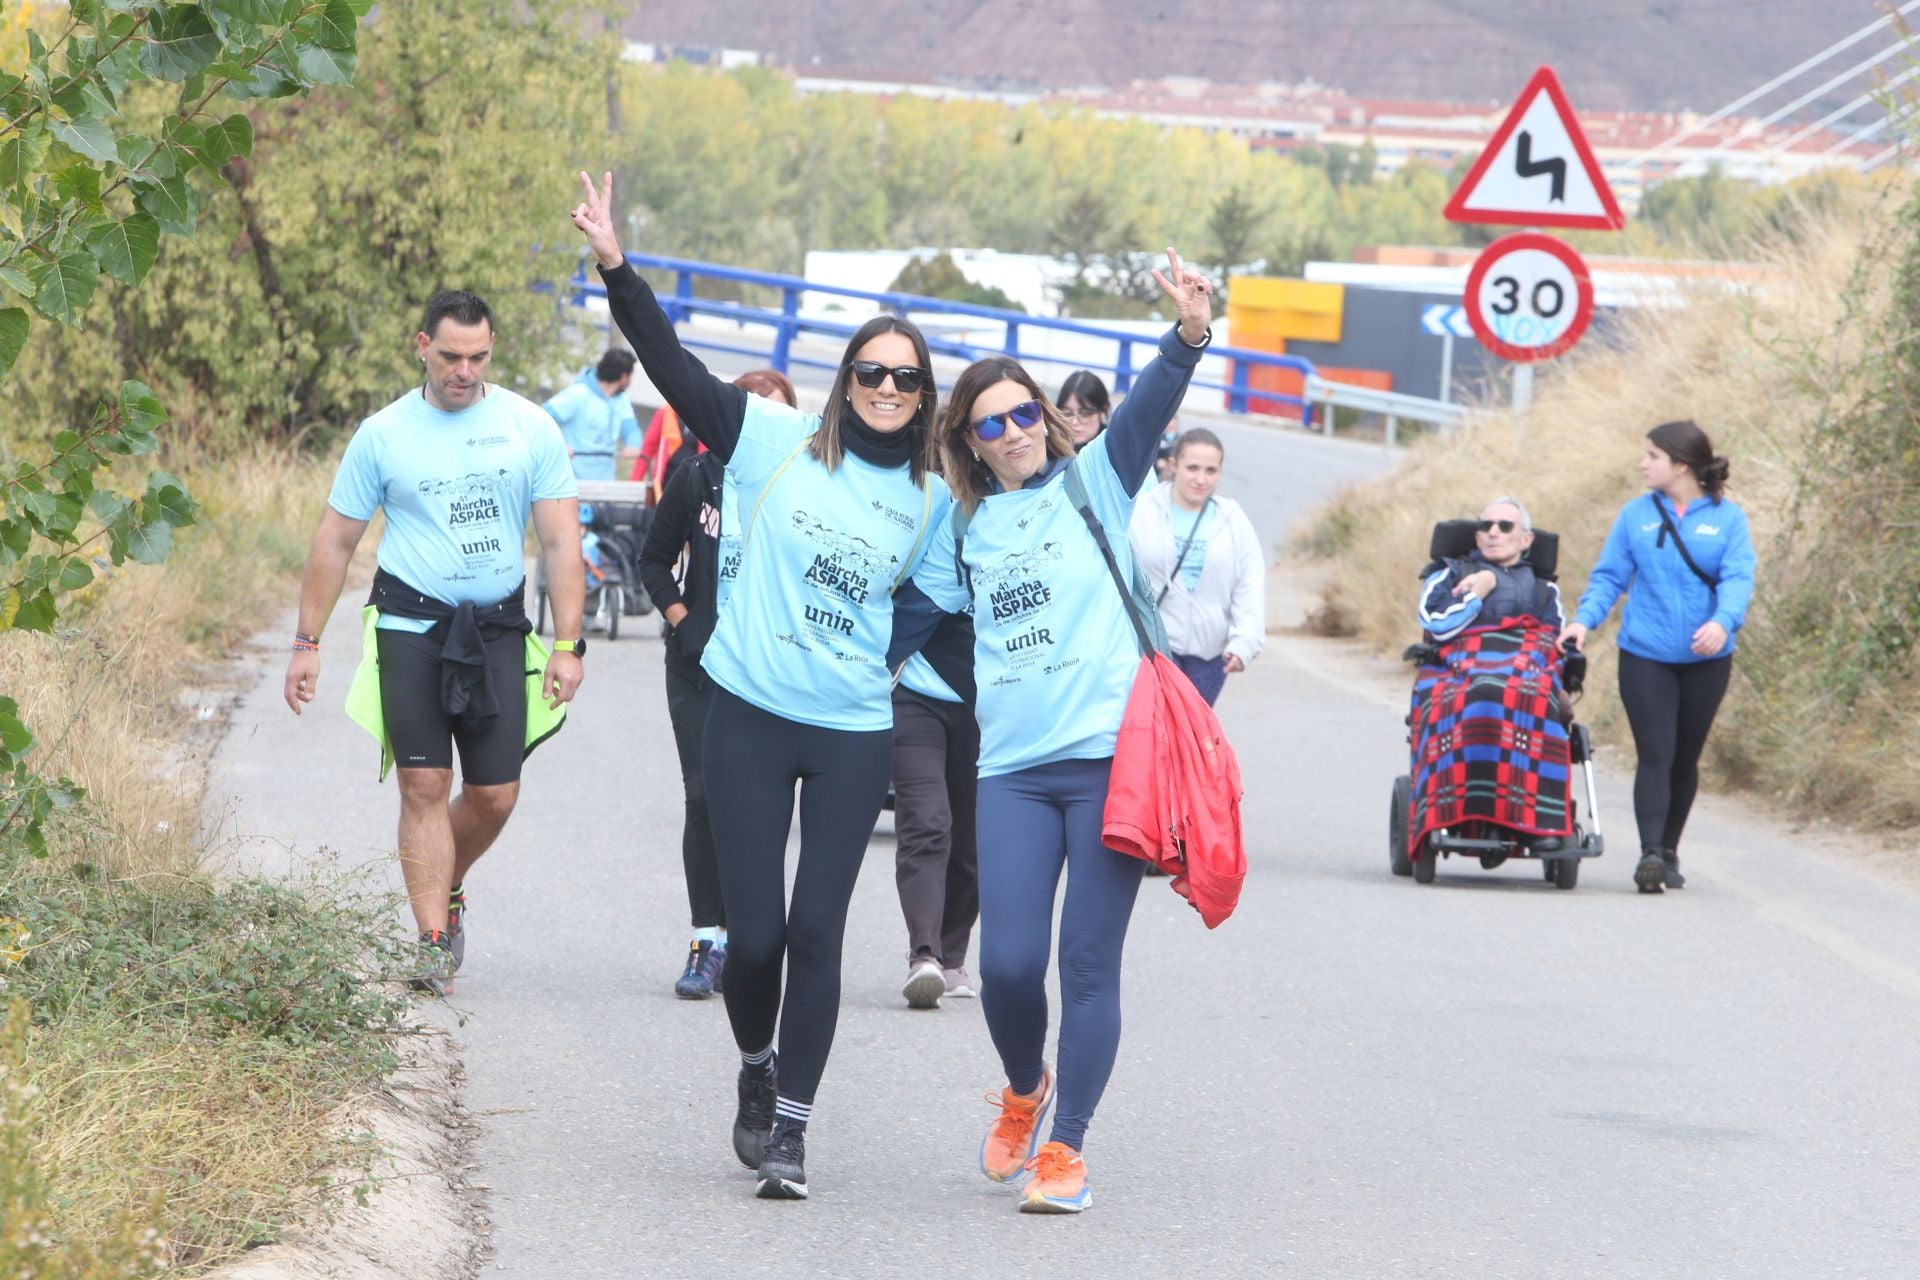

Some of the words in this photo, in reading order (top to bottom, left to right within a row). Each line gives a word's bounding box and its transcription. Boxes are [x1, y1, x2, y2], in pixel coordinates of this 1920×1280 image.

[1492, 277, 1563, 318] 30
[449, 505, 500, 525] ASPACE
[450, 497, 494, 512] Marcha
[830, 553, 842, 564] 41
[814, 553, 868, 589] Marcha
[804, 565, 869, 604] ASPACE
[990, 580, 1043, 605] Marcha
[998, 581, 1009, 591] 41
[992, 587, 1051, 621] ASPACE
[1053, 664, 1061, 672] La
[1062, 657, 1080, 668] Rioja
